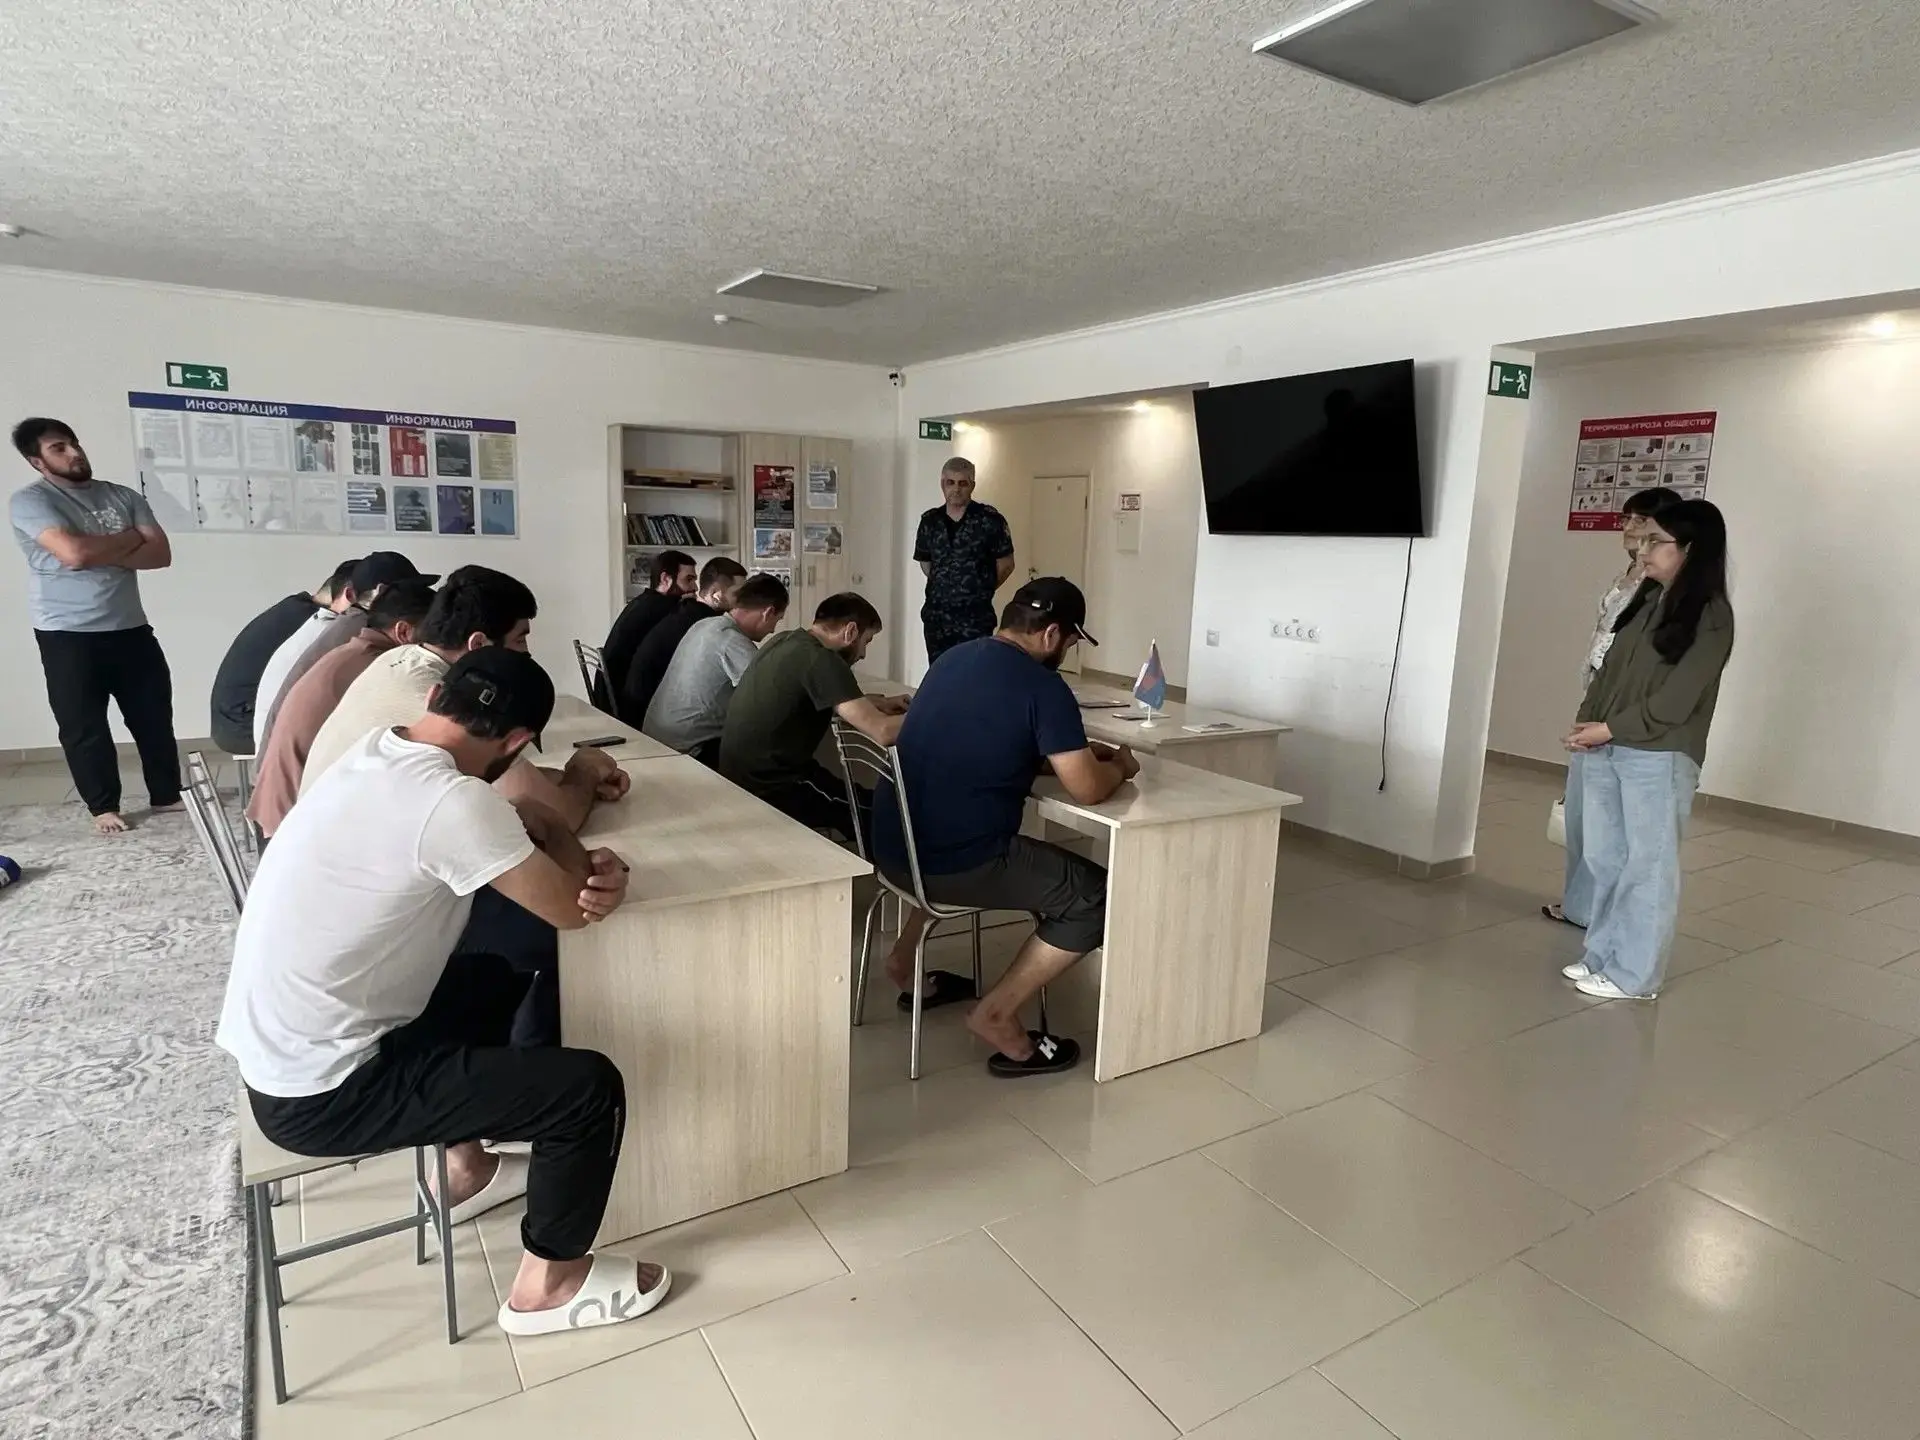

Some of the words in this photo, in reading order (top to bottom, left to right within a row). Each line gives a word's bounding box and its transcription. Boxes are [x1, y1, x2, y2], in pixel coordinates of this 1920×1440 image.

[185, 398, 288, 416] ИНФОРМАЦИЯ
[385, 413, 474, 430] ИНФОРМАЦИЯ
[1664, 418, 1712, 429] ОБЩЕСТВУ
